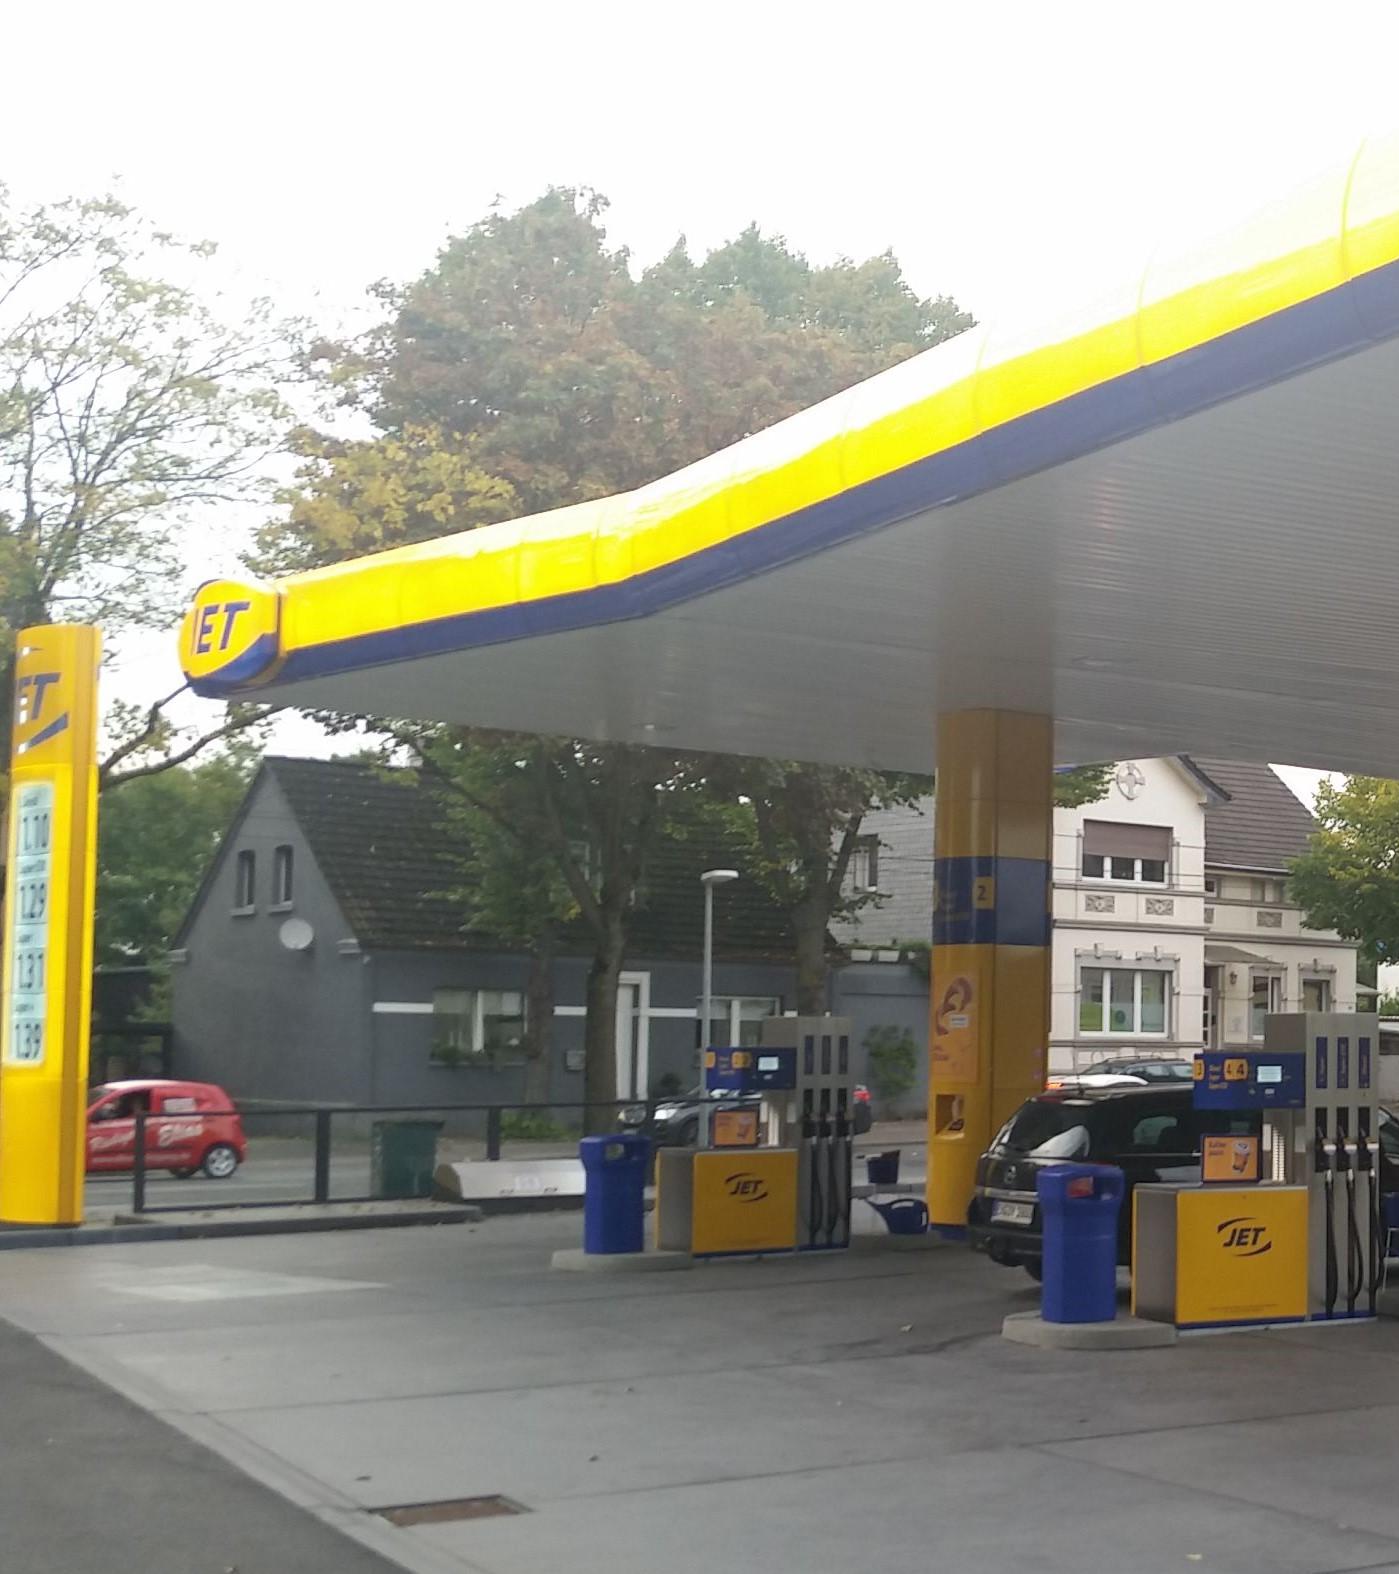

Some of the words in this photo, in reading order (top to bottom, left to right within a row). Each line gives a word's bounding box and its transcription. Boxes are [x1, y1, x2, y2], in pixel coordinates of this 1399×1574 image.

[977, 885, 987, 902] 2
[1237, 1063, 1245, 1075] 4
[730, 1179, 763, 1195] JET
[1223, 1226, 1266, 1247] JET
